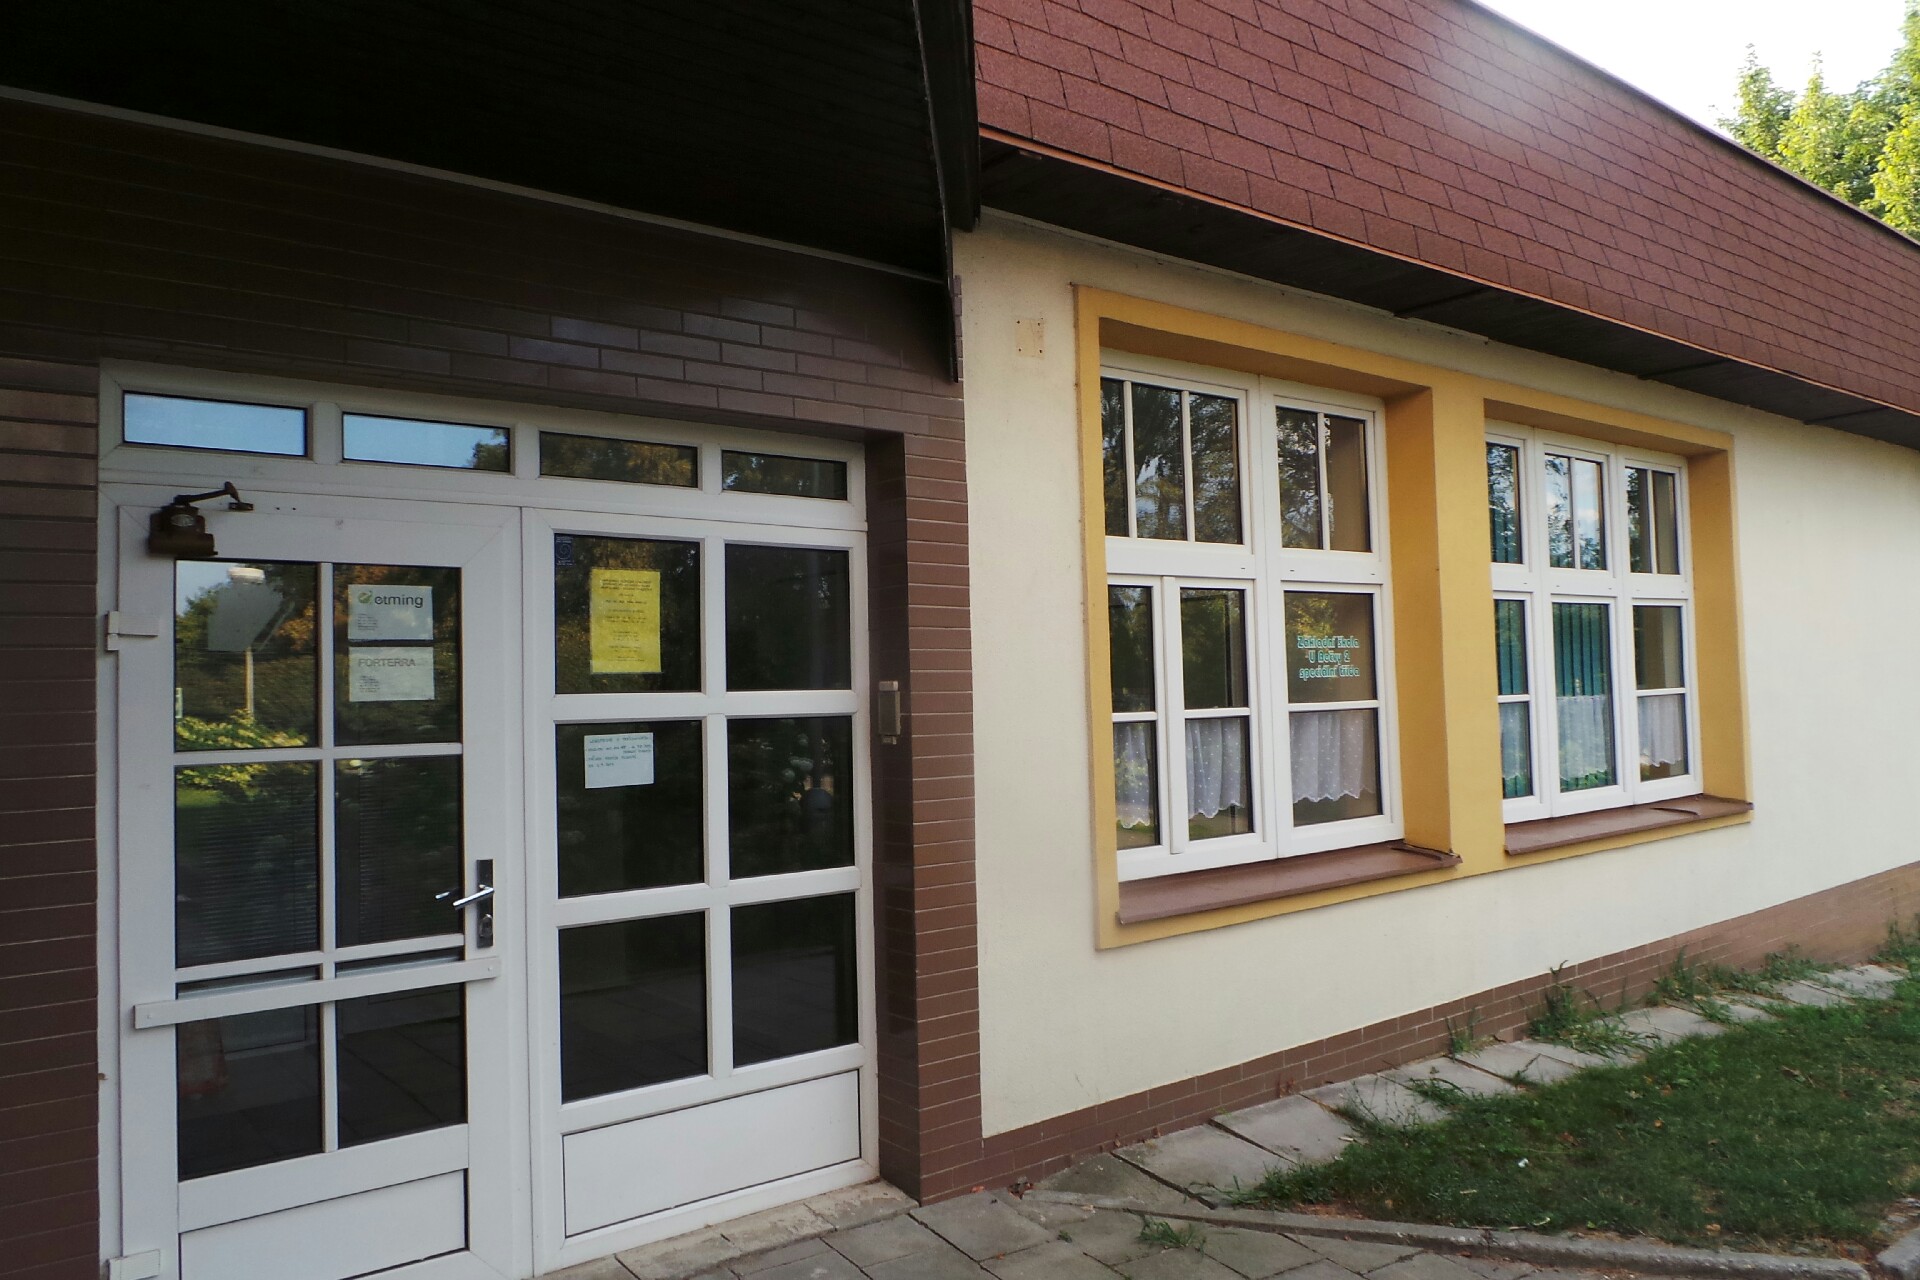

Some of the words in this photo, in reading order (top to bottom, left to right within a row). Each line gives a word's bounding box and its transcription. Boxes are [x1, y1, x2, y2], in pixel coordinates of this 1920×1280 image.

[375, 594, 423, 608] etming
[1309, 650, 1316, 663] U
[1343, 650, 1350, 662] 2
